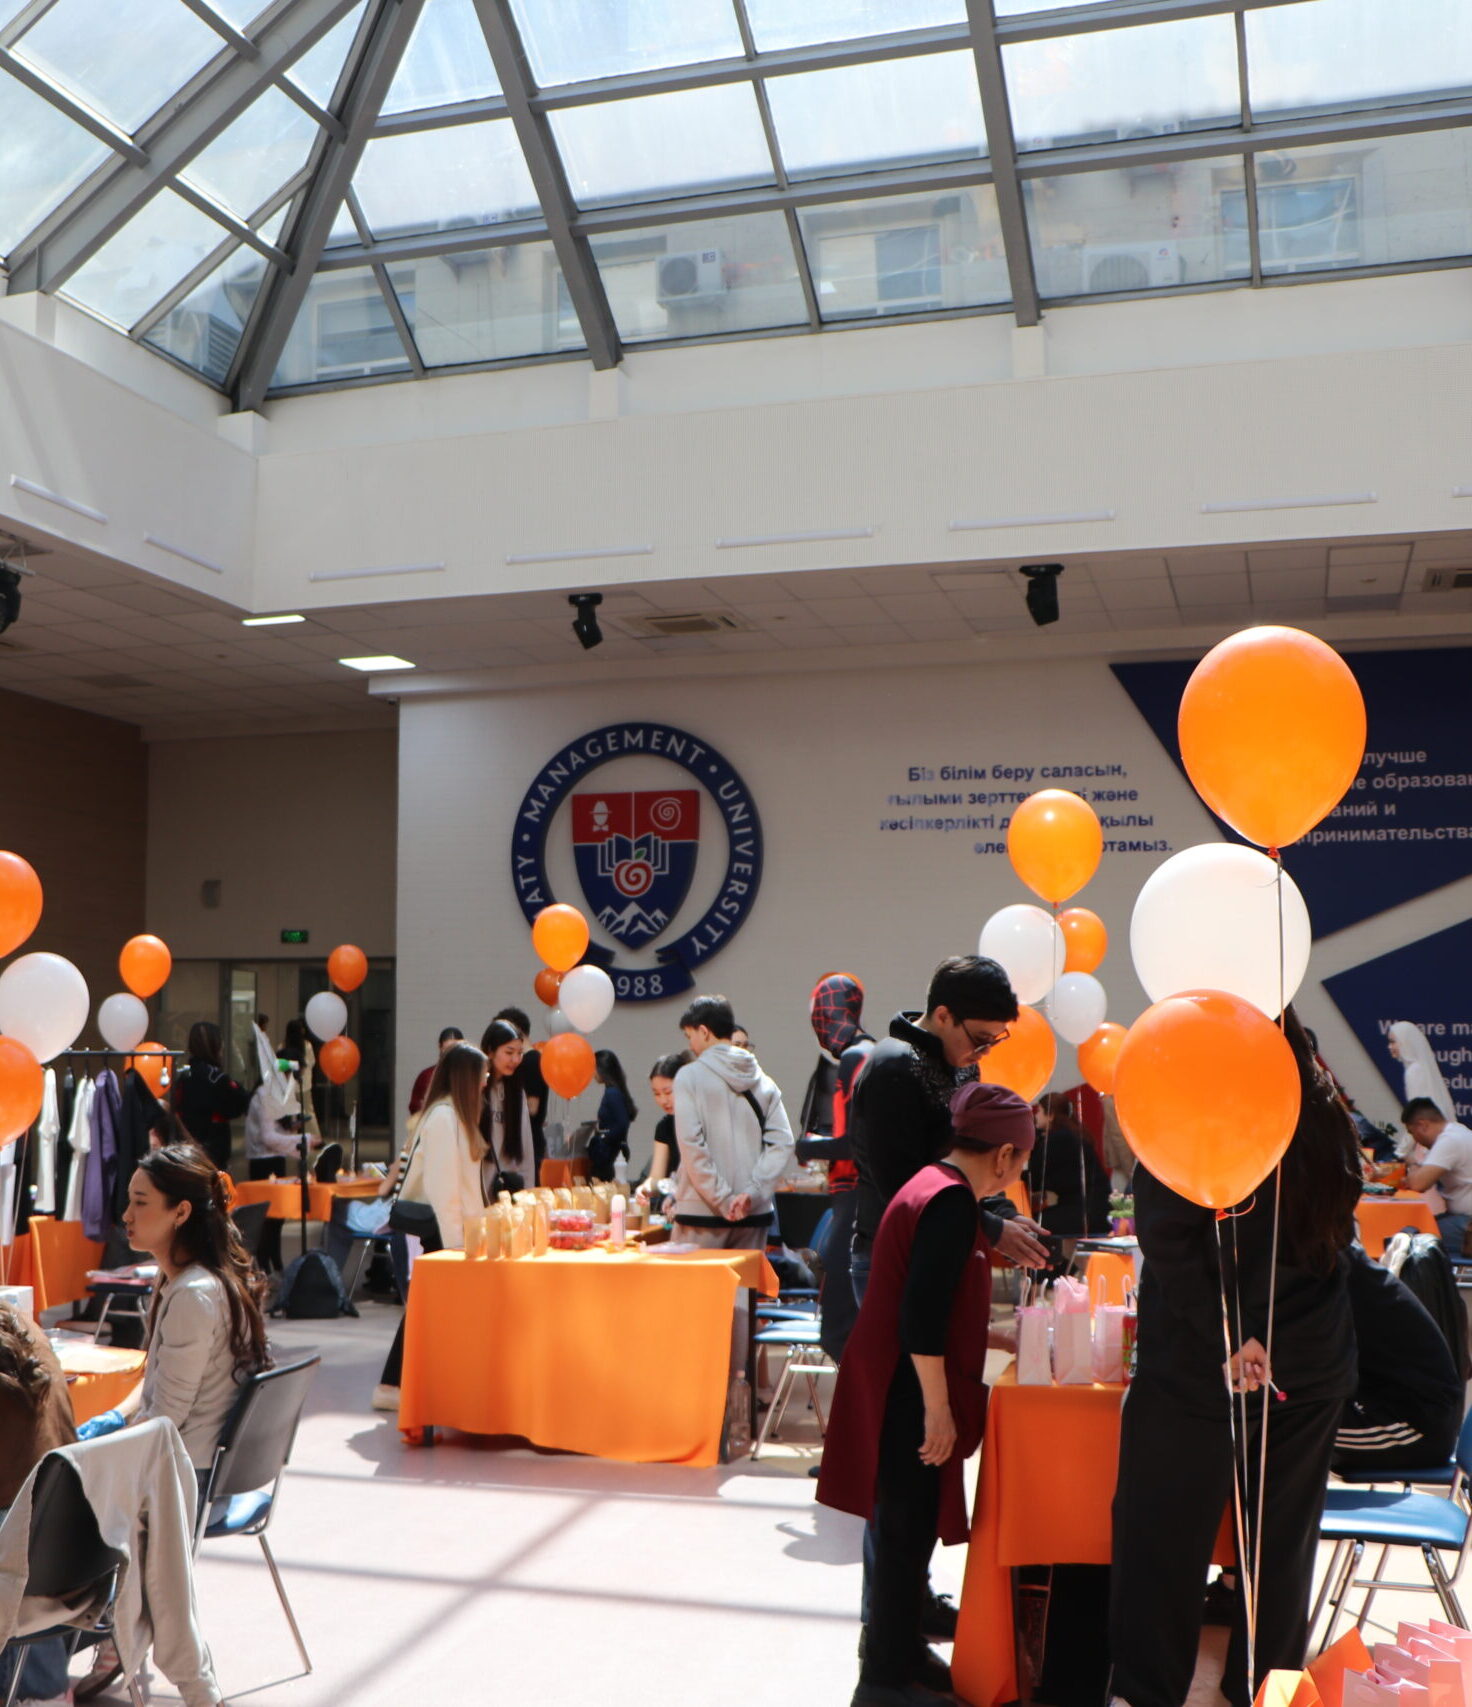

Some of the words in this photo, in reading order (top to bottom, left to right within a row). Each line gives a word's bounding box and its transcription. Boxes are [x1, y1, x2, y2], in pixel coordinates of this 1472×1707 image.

[1363, 750, 1427, 769] лучше
[524, 729, 706, 823] MANAGEMENT
[908, 767, 935, 782] Біз
[940, 765, 987, 781] білім
[991, 764, 1035, 783] беру
[1041, 763, 1128, 780] саласын,
[1092, 789, 1139, 802] және
[1328, 801, 1378, 818] аний
[1384, 802, 1397, 816] и
[1101, 815, 1154, 829] қылы
[1297, 826, 1472, 846] принимательств
[692, 780, 754, 956] UNIVERSITY
[517, 855, 545, 904] ATY
[616, 974, 664, 997] 988
